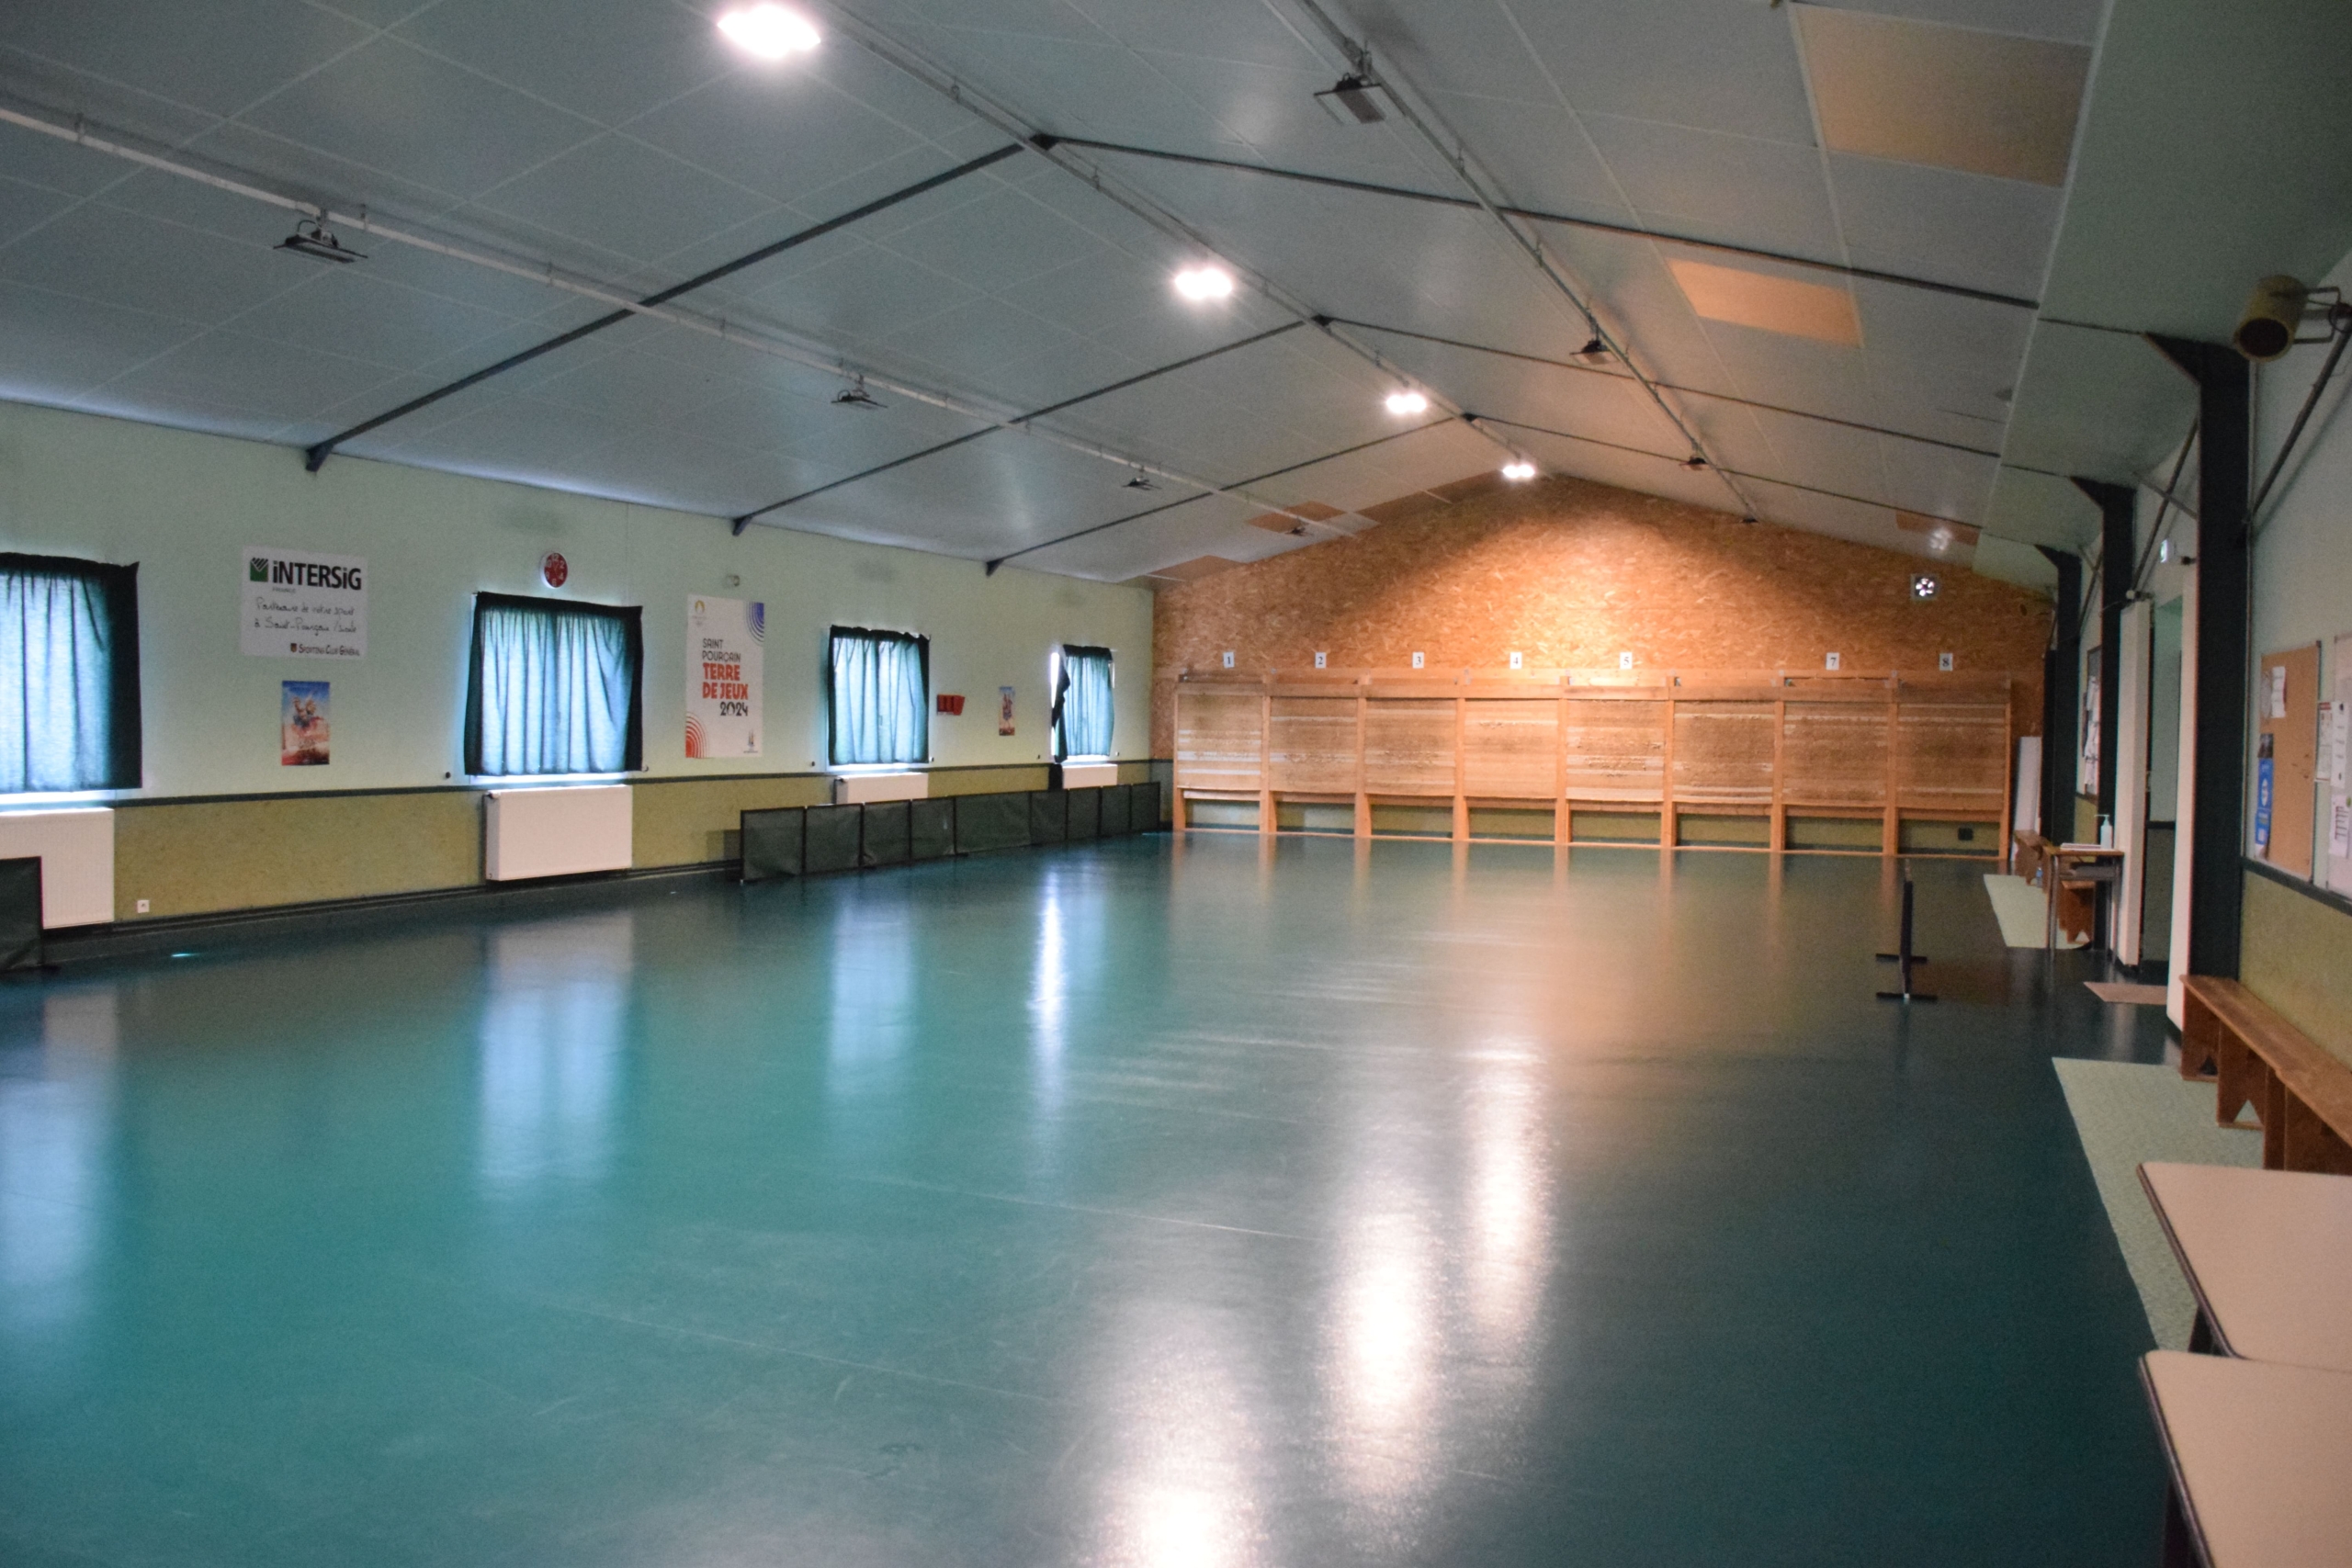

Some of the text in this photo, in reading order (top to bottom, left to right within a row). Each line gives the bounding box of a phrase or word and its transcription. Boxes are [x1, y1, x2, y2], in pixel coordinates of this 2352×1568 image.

[560, 560, 564, 569] 2
[702, 637, 723, 649] SAINT
[702, 650, 741, 663] POURÇAIN
[1227, 656, 1231, 664] 1
[1318, 656, 1323, 665] 2
[1416, 656, 1421, 665] 3
[1512, 657, 1519, 665] 4
[1623, 656, 1629, 666] 5
[1830, 657, 1837, 666] 7
[1942, 658, 1950, 667] 8
[702, 662, 741, 681] TERRE
[702, 682, 749, 700] DE JEUX
[719, 701, 749, 716] 2024
